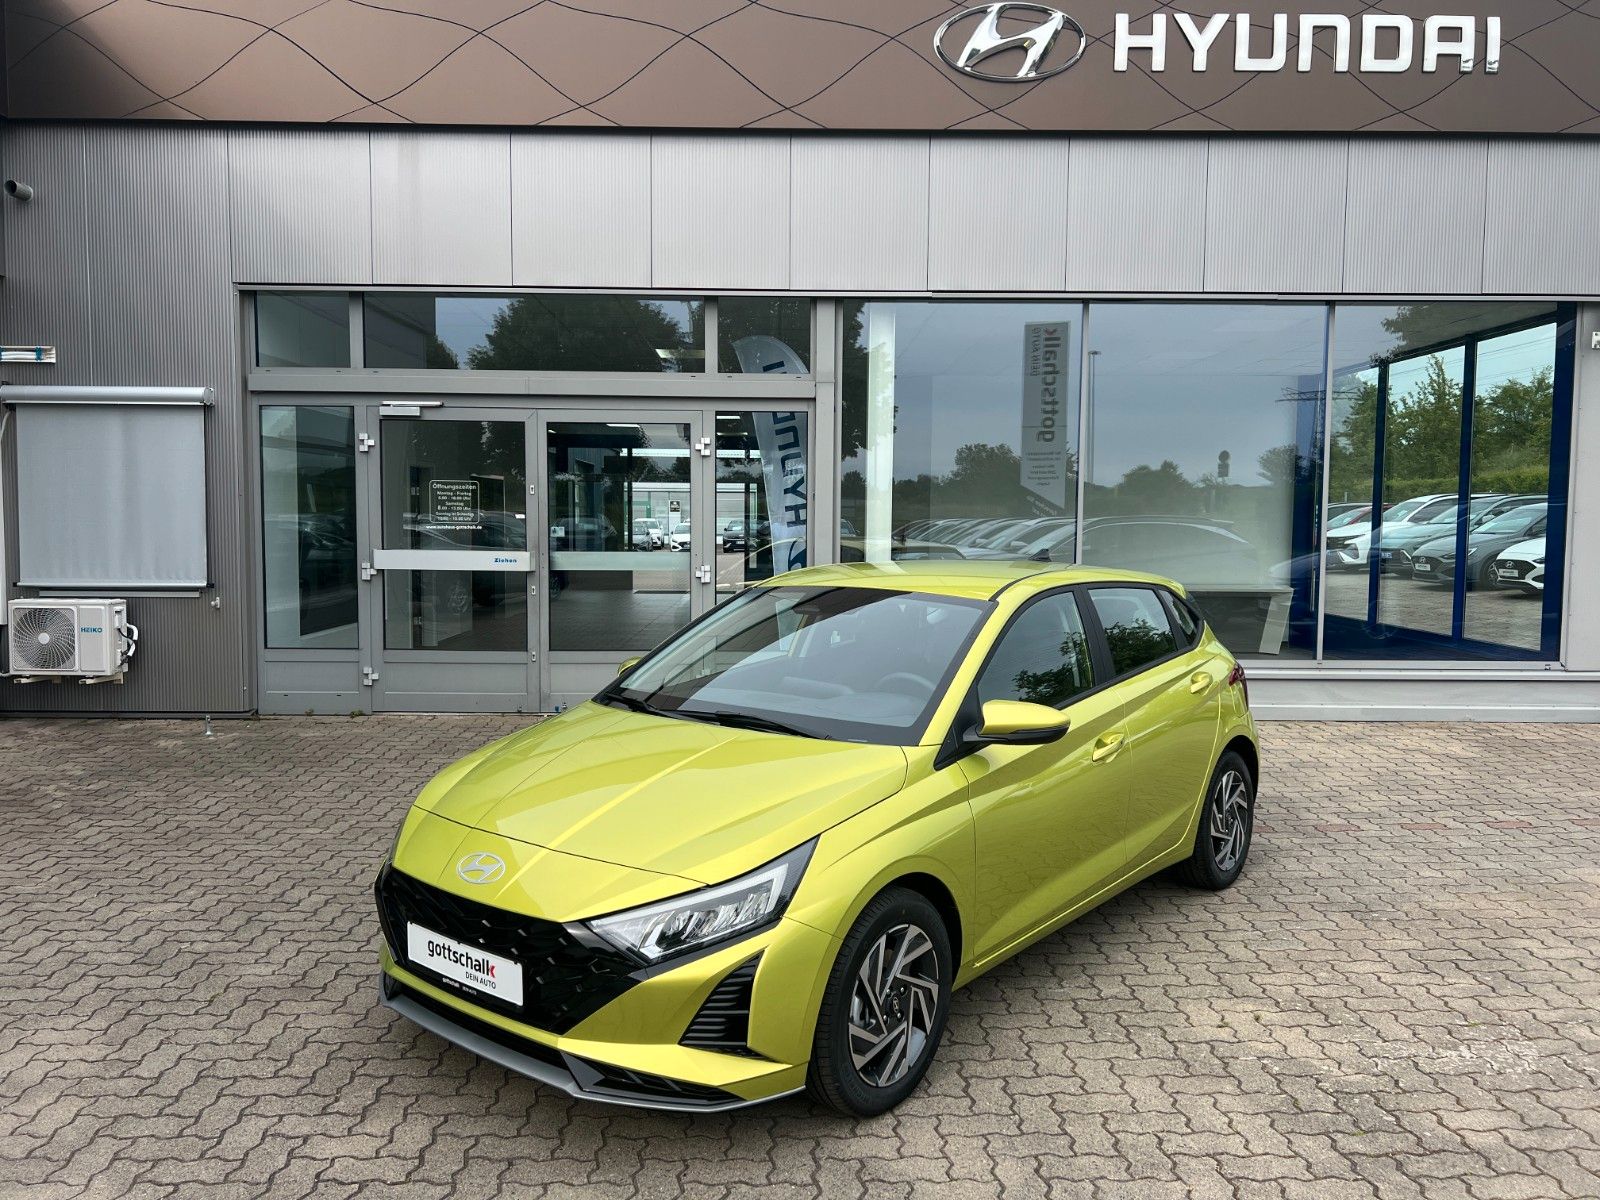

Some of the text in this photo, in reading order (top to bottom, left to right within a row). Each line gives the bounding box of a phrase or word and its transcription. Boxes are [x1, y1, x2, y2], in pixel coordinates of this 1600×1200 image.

[1113, 13, 1501, 73] HYUNDAI
[432, 482, 477, 490] Öffnungszeiten
[428, 940, 496, 978] gottschalk
[465, 971, 479, 983] DEIN
[480, 976, 496, 989] AUTO
